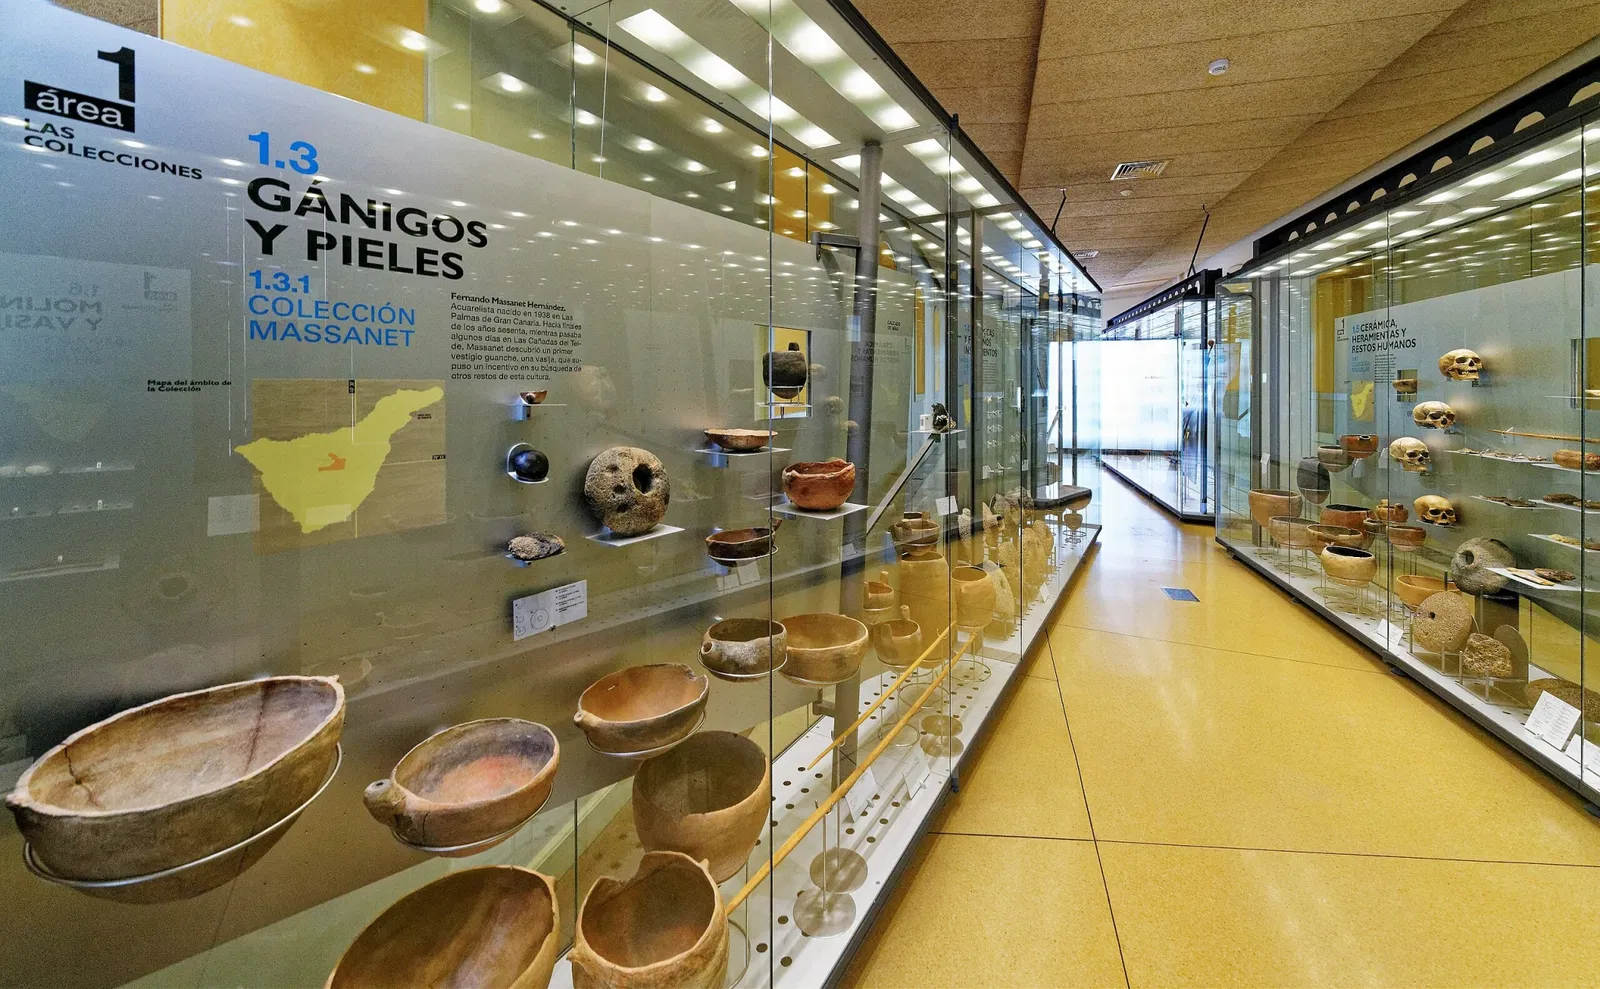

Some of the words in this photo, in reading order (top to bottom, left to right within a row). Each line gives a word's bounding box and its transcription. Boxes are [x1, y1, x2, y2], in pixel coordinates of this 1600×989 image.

[97, 46, 135, 103] 1
[36, 89, 124, 128] área
[24, 118, 75, 139] LAS
[24, 136, 203, 180] COLECCIONES
[248, 131, 320, 175] 1.3
[247, 177, 488, 248] GÁNIGOS
[245, 218, 288, 255] Y
[307, 229, 464, 280] PIELES
[249, 270, 311, 294] 1.3.1
[249, 294, 415, 326] COLECCIÓN
[451, 292, 490, 303] Fernando
[491, 297, 526, 307] Massanet
[527, 301, 566, 311] Hernández.
[451, 302, 495, 314] Acuarelista
[496, 308, 521, 316] nacido
[534, 311, 550, 319] 1938
[451, 312, 480, 322] Palmas
[493, 316, 511, 324] Gran
[513, 317, 541, 327] Canaria.
[542, 321, 561, 329] Hacia
[562, 322, 582, 330] finales
[1360, 319, 1397, 332] CERÁMICA,
[250, 320, 415, 347] MASSANET
[451, 333, 482, 342] algunos
[485, 334, 501, 343] días
[528, 336, 558, 346] Cañadas
[463, 323, 475, 331] los
[477, 324, 496, 333] años
[497, 326, 528, 336] sesenta,
[530, 329, 558, 338] mientras
[559, 331, 582, 339] pasaba
[1401, 328, 1407, 338] Y
[466, 343, 504, 351] Massanet
[505, 345, 541, 353] descubrió
[1352, 343, 1376, 353] RESTOS
[1377, 339, 1416, 351] HUMANOS
[451, 352, 483, 362] vestigio
[485, 354, 519, 362] guanche,
[535, 355, 557, 364] vasija,
[451, 363, 472, 371] puso
[485, 363, 519, 371] incentivo
[541, 364, 573, 372] búsqueda
[147, 380, 172, 388] Mapa
